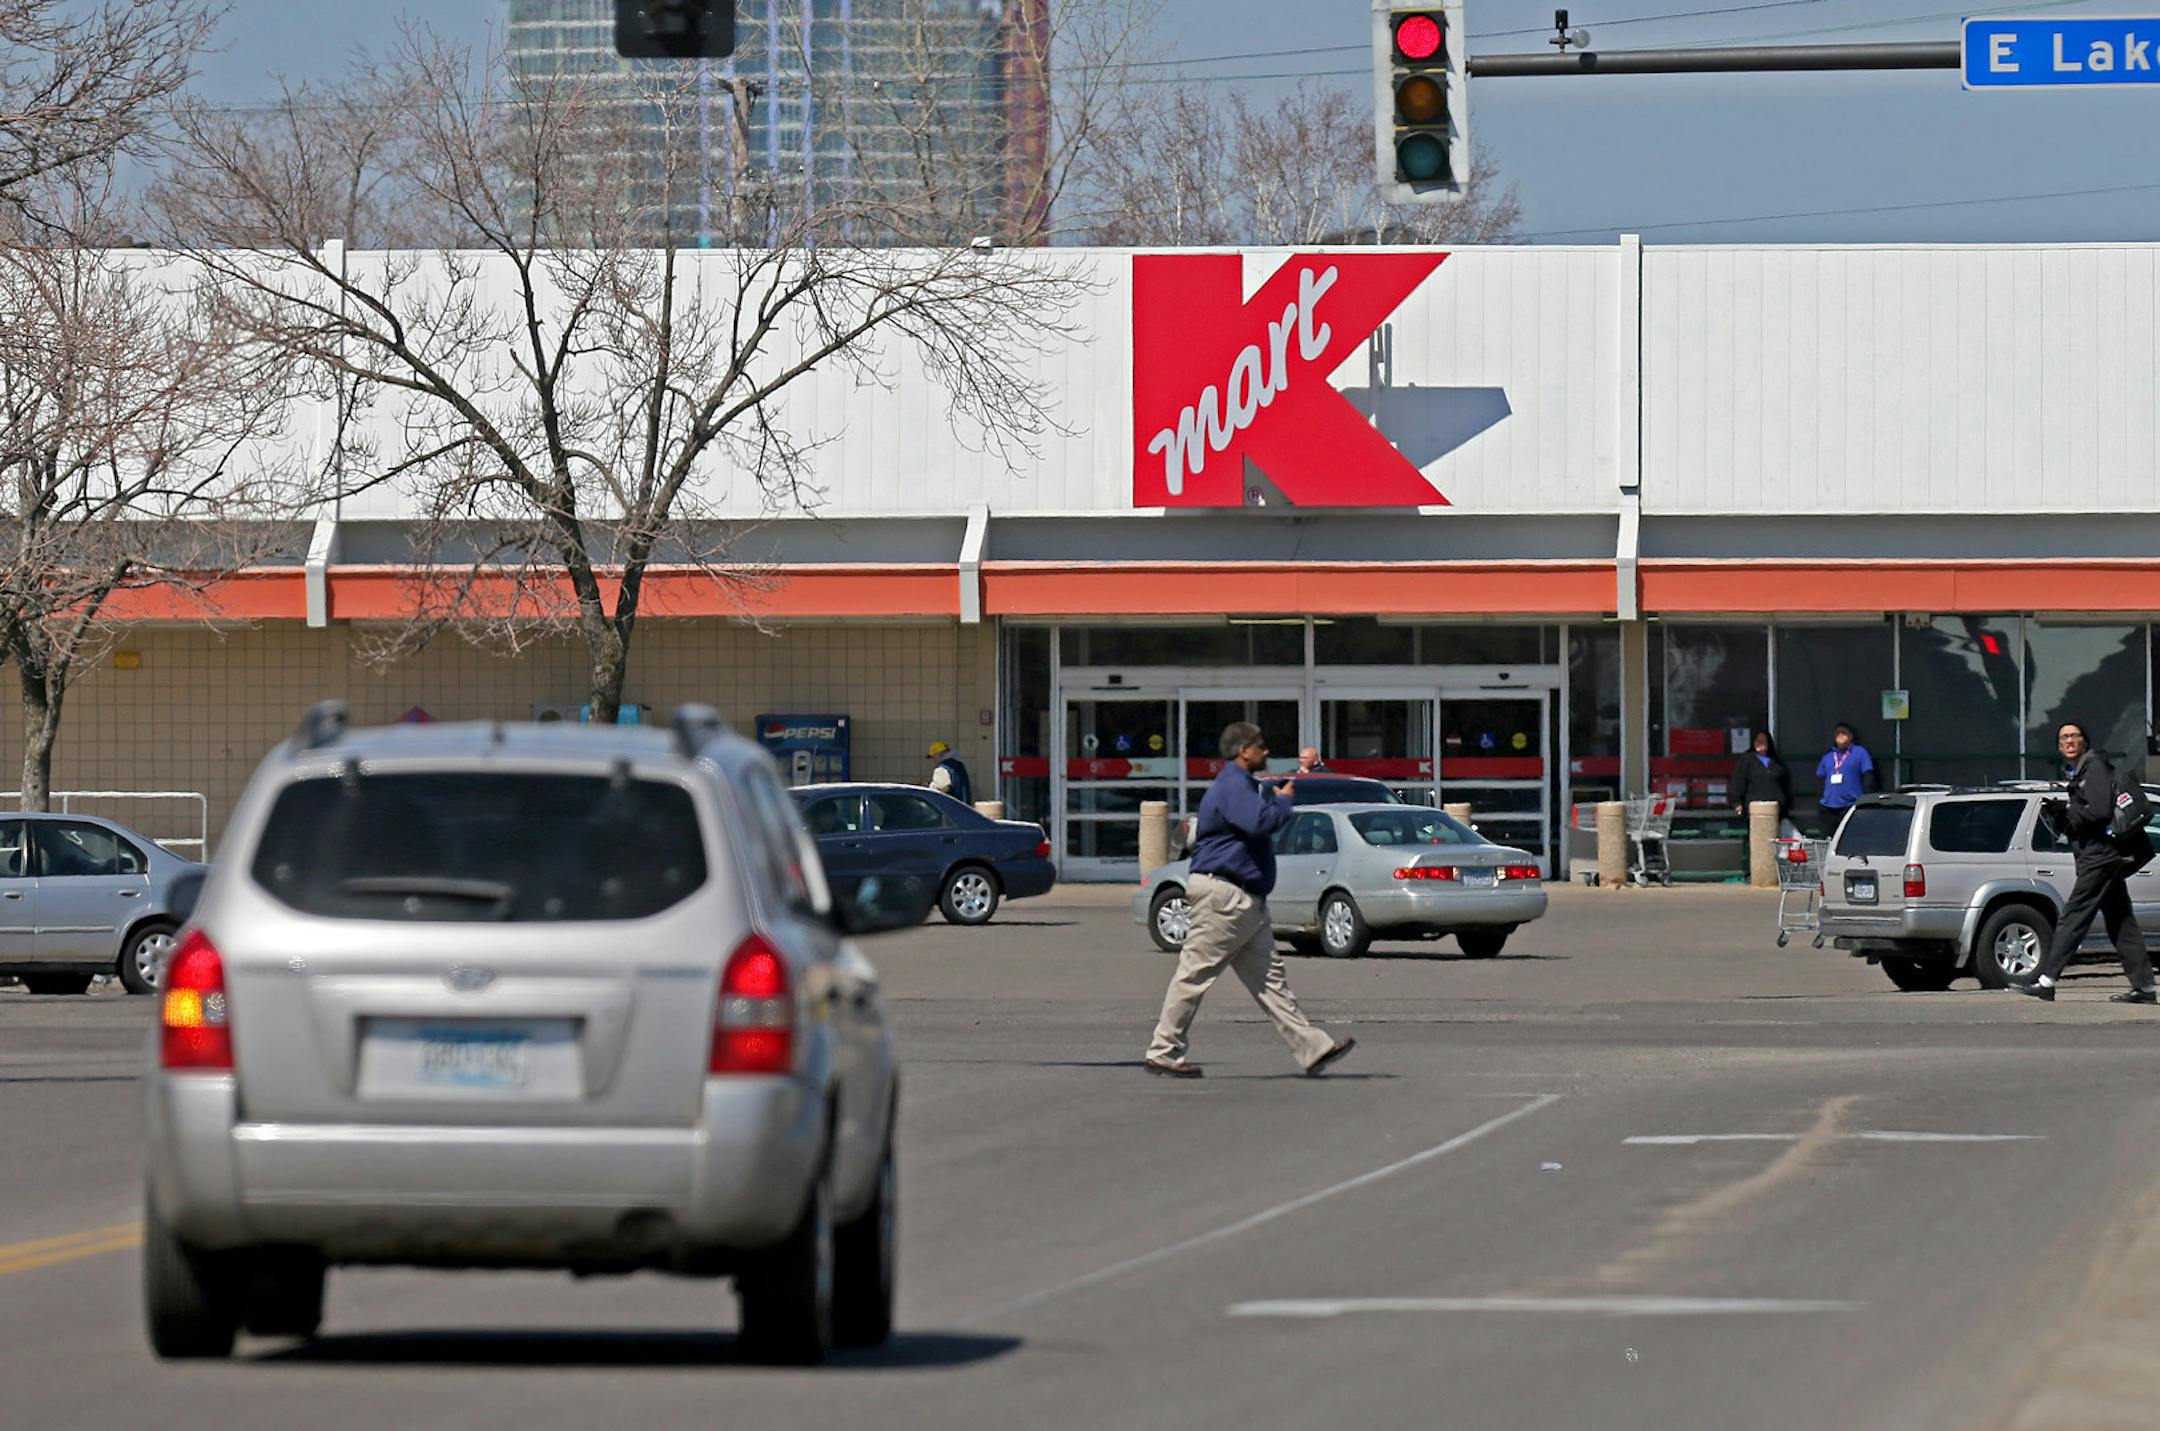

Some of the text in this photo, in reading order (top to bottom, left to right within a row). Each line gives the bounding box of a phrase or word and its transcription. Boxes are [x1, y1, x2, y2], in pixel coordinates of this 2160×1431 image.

[1989, 32, 2160, 73] E Lak
[1147, 265, 1339, 496] mart
[784, 727, 836, 739] PEPSI
